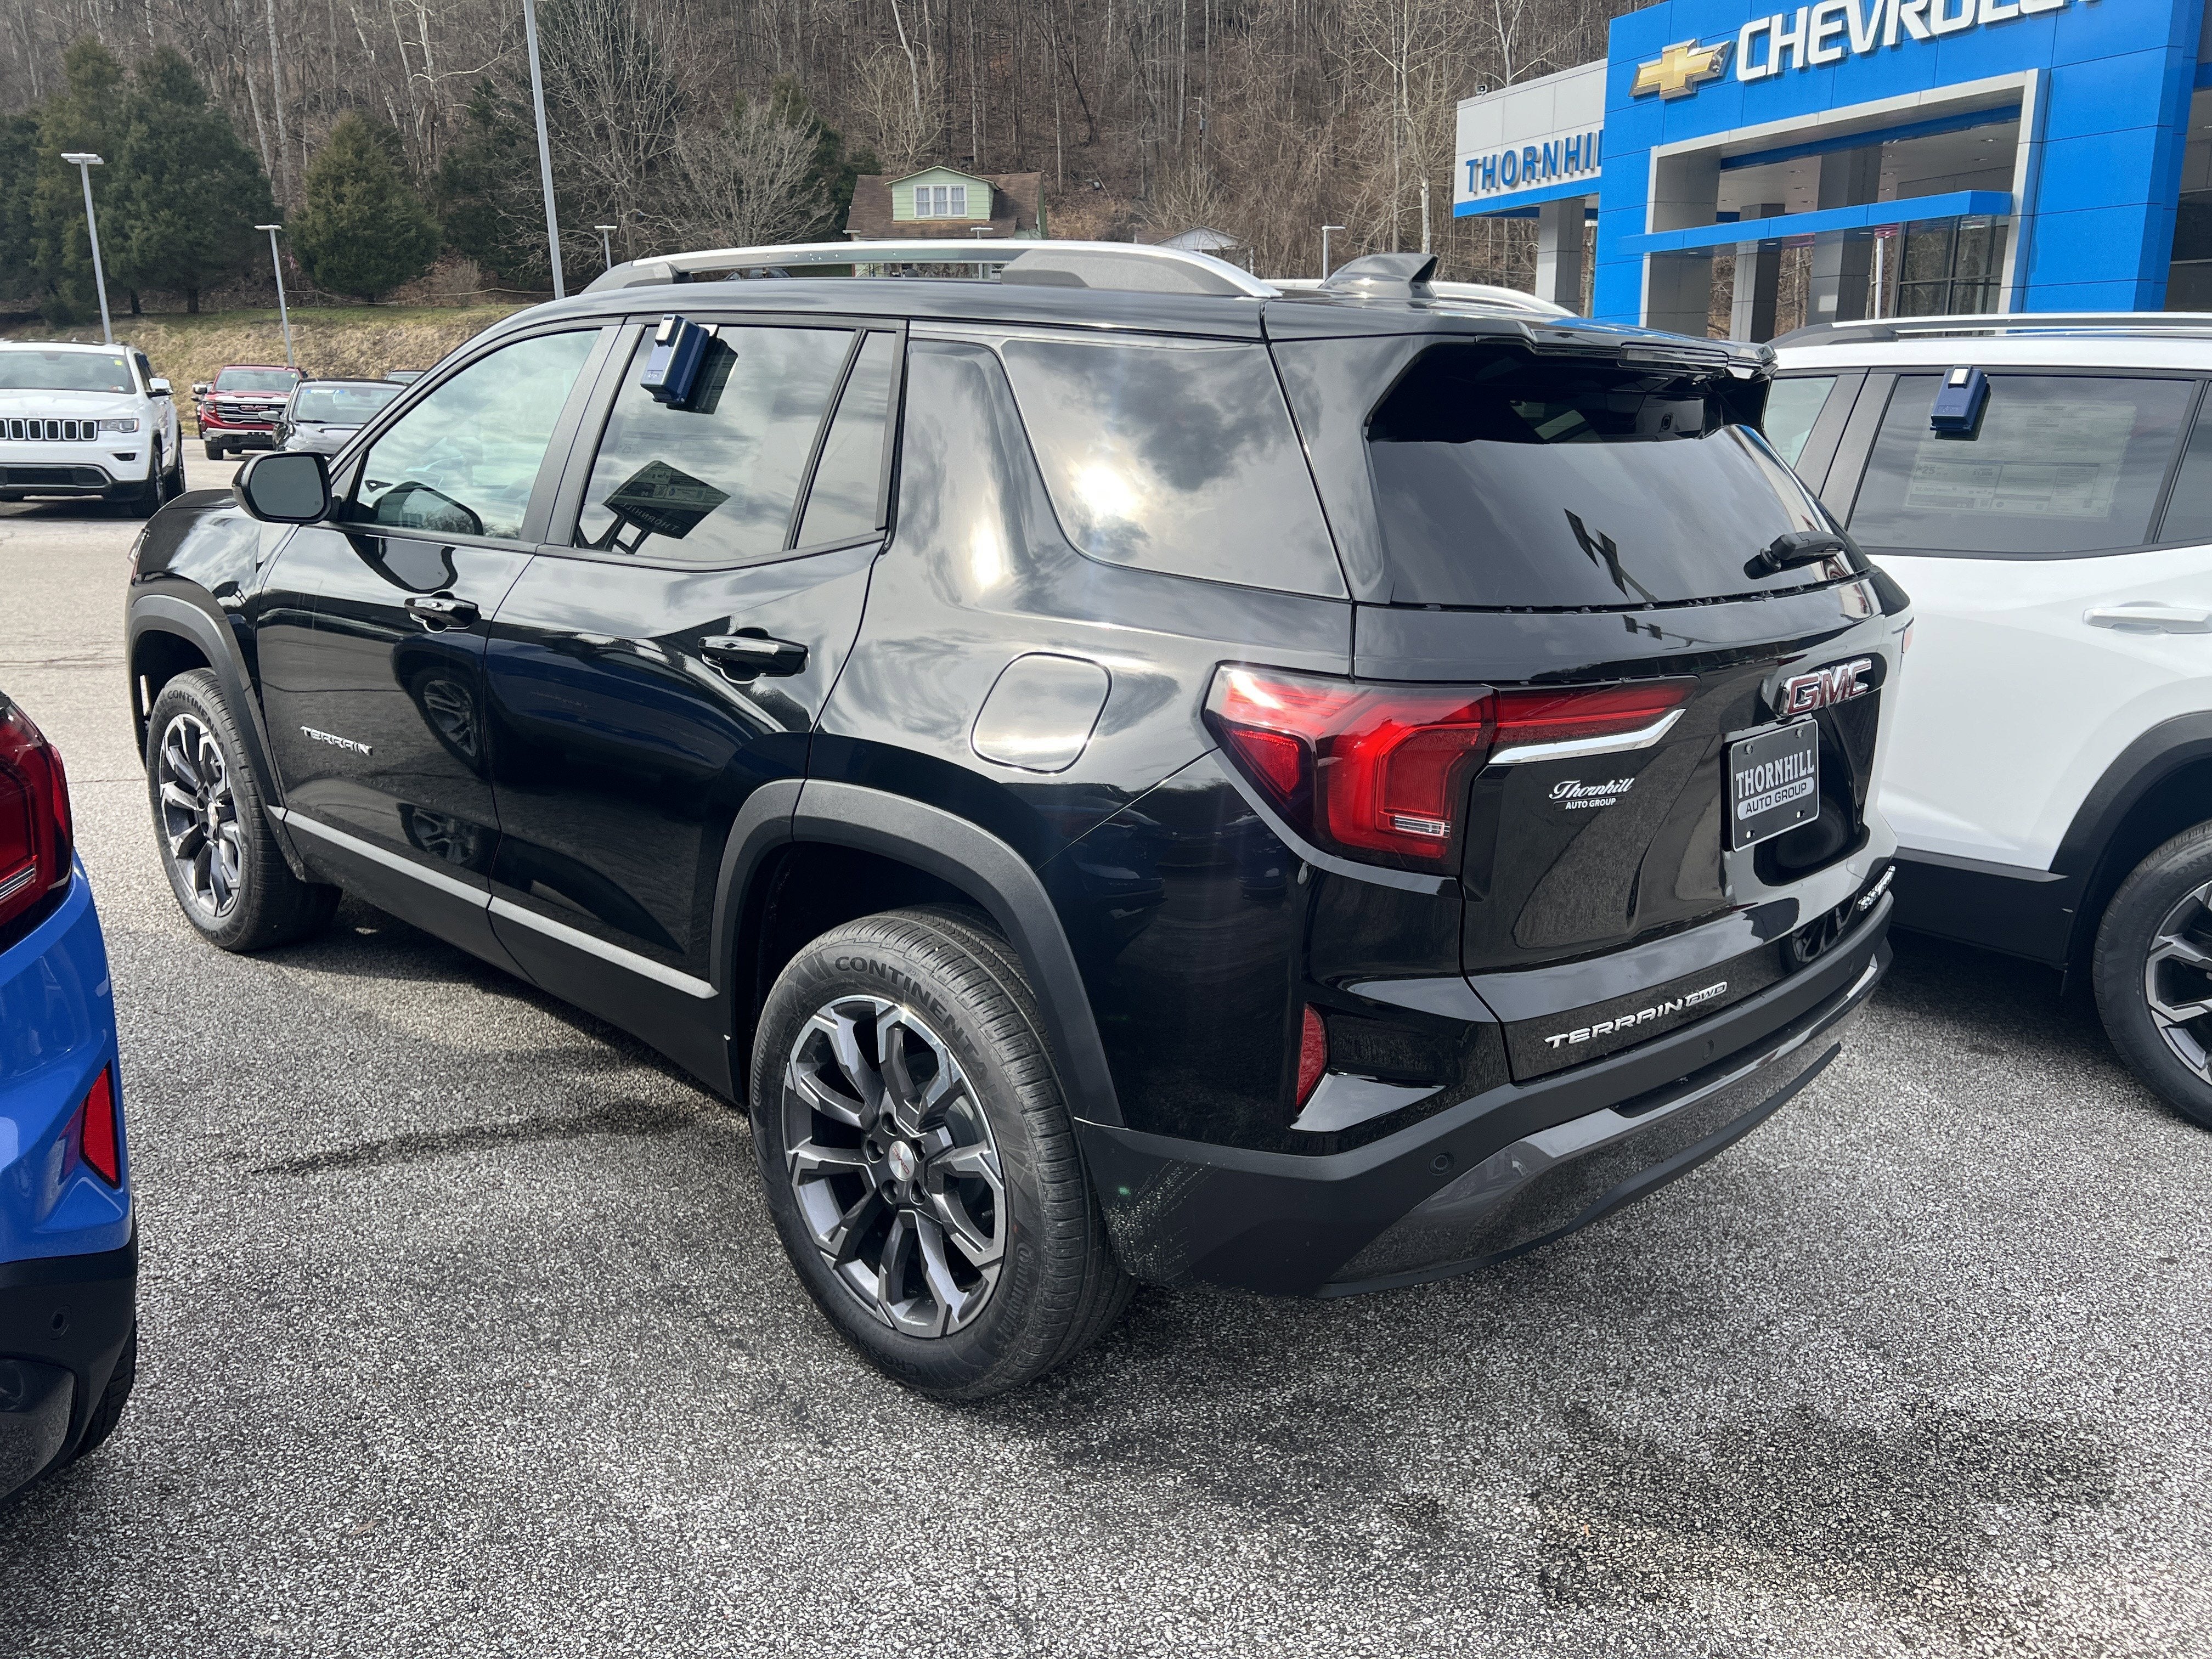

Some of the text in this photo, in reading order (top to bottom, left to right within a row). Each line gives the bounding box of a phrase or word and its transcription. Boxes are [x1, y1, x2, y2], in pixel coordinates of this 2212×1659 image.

[1736, 0, 2066, 81] CHEVRO
[1466, 129, 1604, 193] THORNHI
[1786, 658, 1872, 716] GMC
[300, 726, 373, 756] TERRAIN
[1549, 777, 1635, 799] Thornhill
[1735, 749, 1815, 800] THORNHILL
[1745, 782, 1807, 815] AUTO GROUP
[1565, 798, 1616, 810] AUTO GROUP
[835, 956, 1000, 1098] CONTINENTAL
[1544, 982, 1727, 1049] TERRAIN AWD
